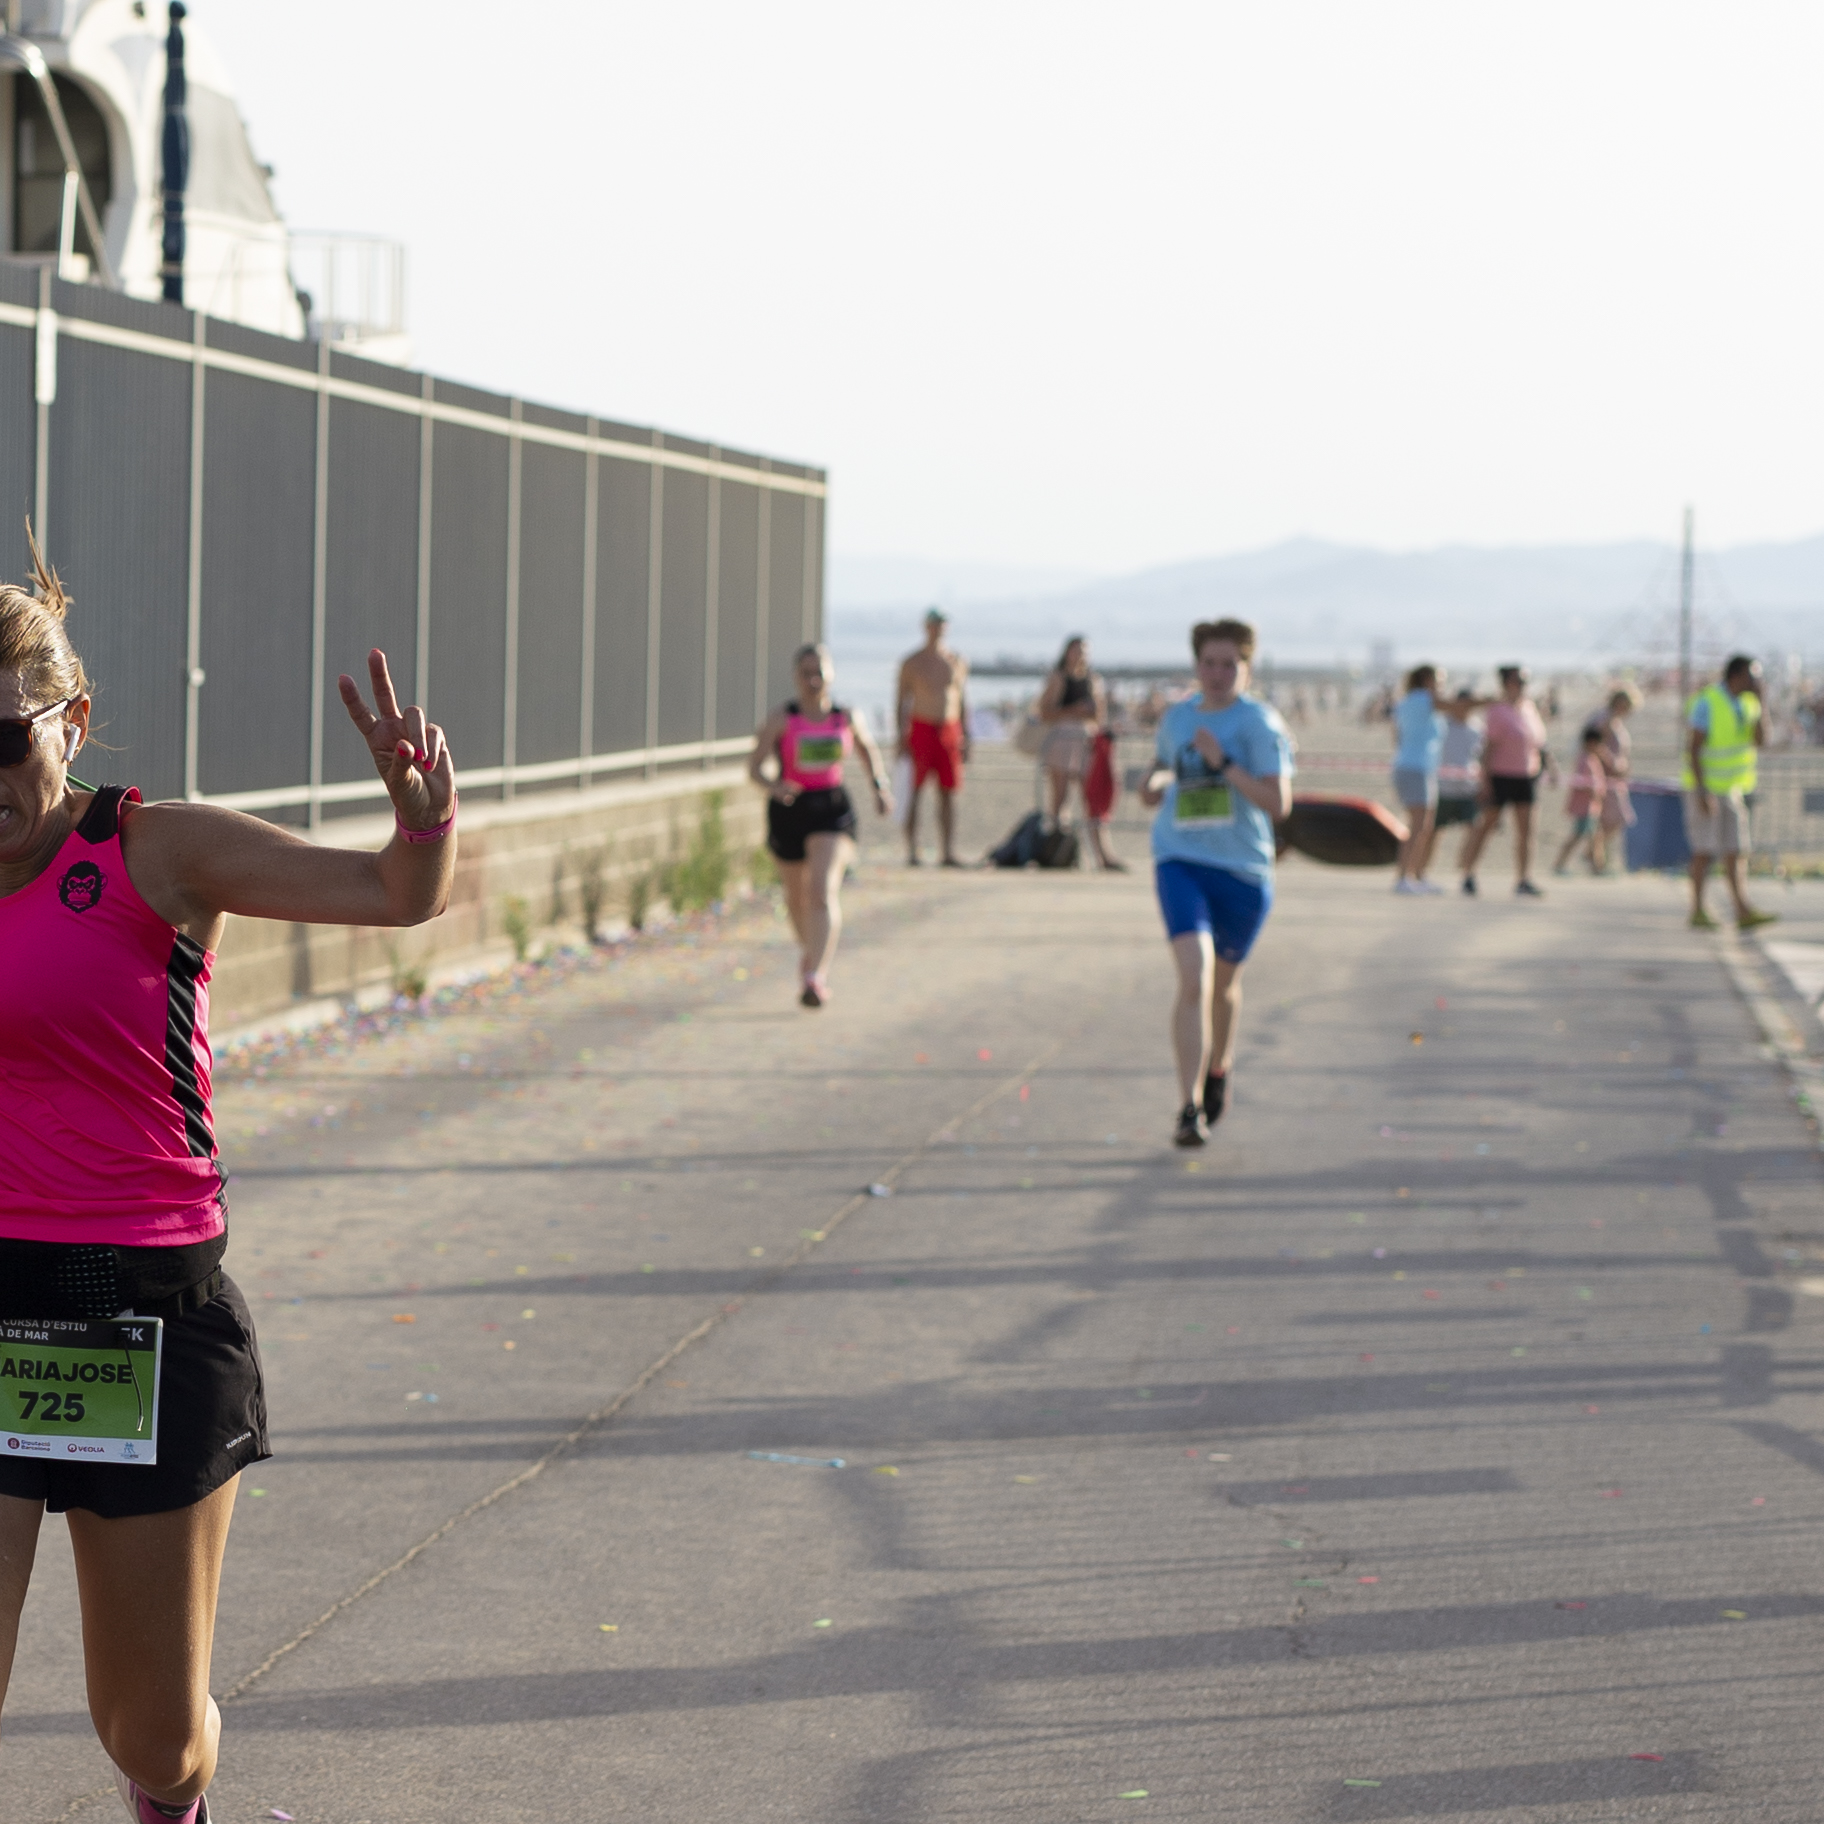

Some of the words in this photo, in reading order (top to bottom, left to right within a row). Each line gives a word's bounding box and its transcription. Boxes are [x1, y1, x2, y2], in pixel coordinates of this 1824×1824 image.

[3, 1317, 39, 1328] CURSA
[42, 1320, 88, 1332] D'ESTIU
[7, 1329, 22, 1339] DE
[24, 1330, 49, 1341] MAR
[18, 1390, 86, 1423] 725
